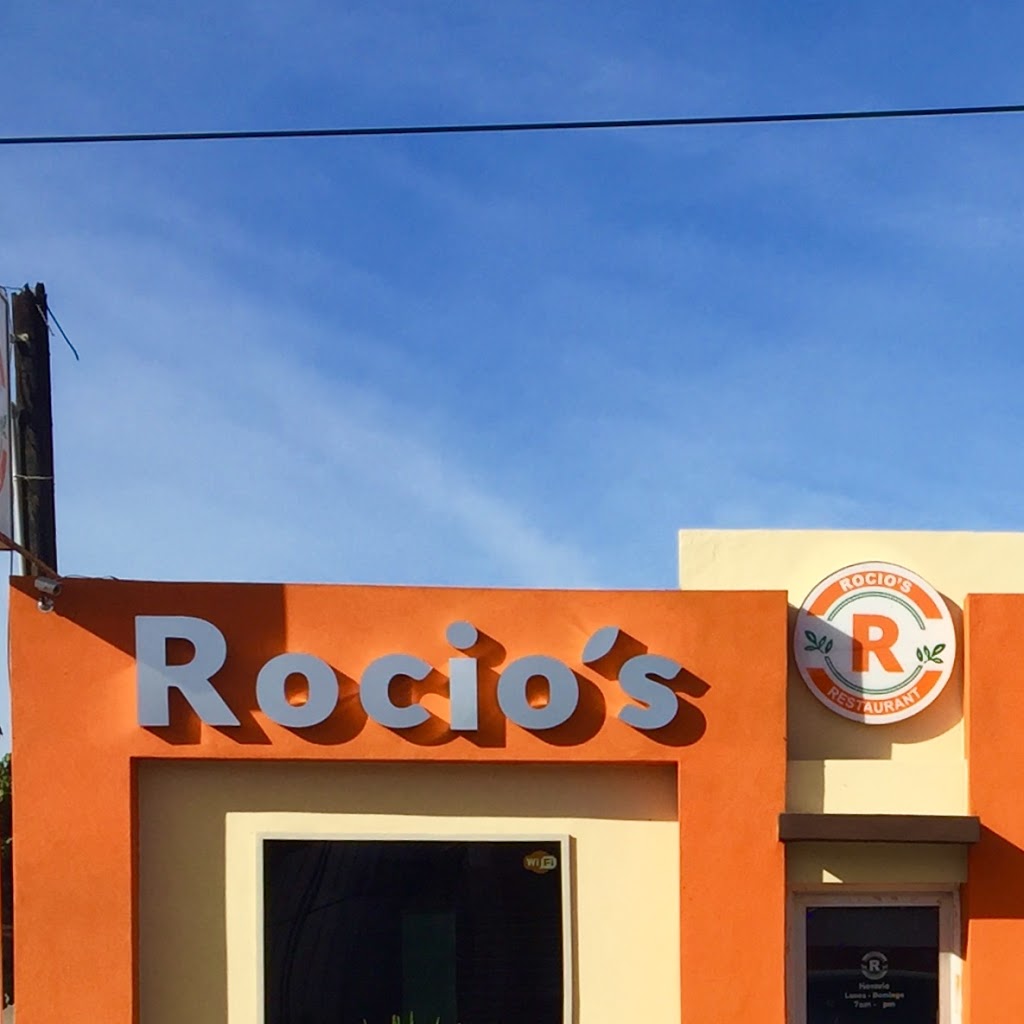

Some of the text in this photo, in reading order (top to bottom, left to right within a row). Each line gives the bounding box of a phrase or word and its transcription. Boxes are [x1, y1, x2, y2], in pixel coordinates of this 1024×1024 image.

[839, 572, 912, 593] ROCIO'S
[852, 613, 904, 673] R
[135, 615, 682, 731] Rocio's
[827, 686, 921, 714] RESTAURANT
